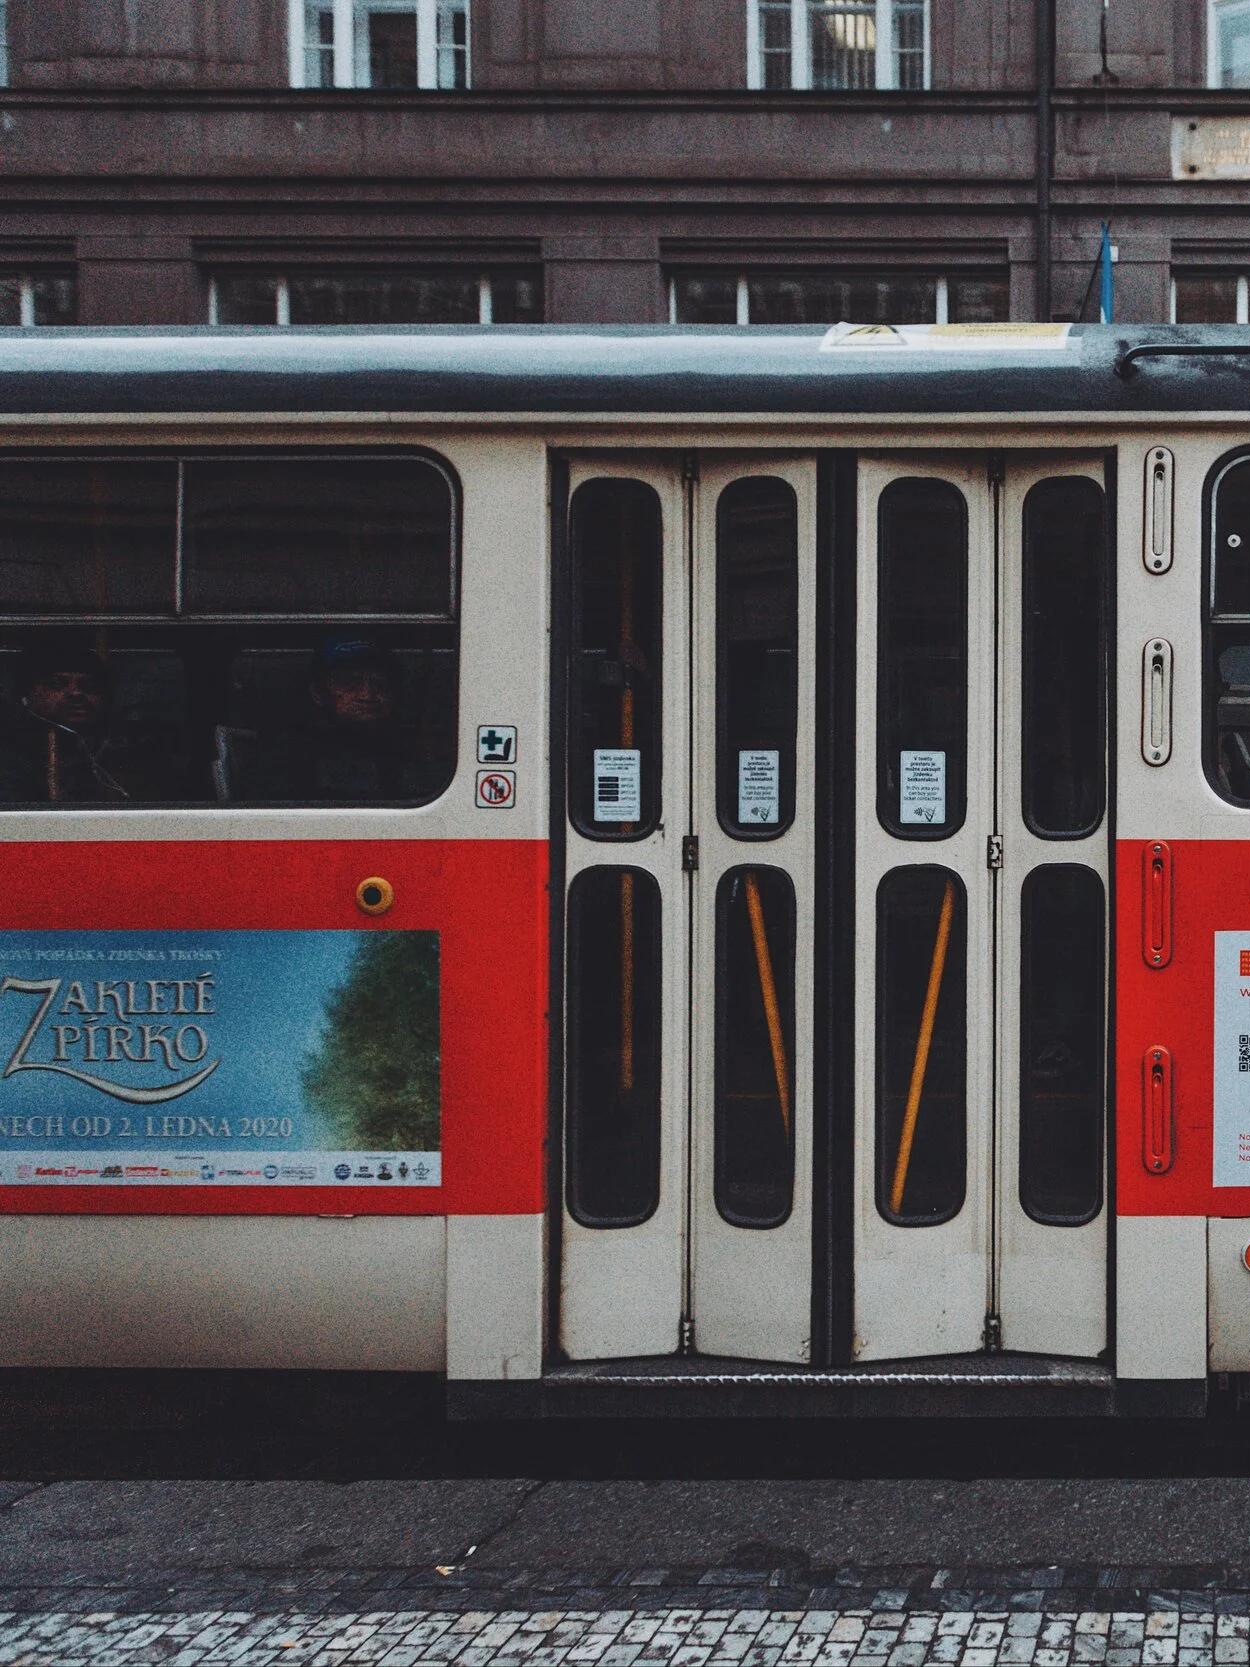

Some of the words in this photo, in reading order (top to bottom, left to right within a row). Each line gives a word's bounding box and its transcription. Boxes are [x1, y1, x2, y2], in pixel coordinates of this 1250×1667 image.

[50, 1018, 209, 1071] PÍRKO
[72, 1115, 111, 1137] OD
[145, 1115, 232, 1137] LEDNA
[240, 1116, 292, 1138] 2020
